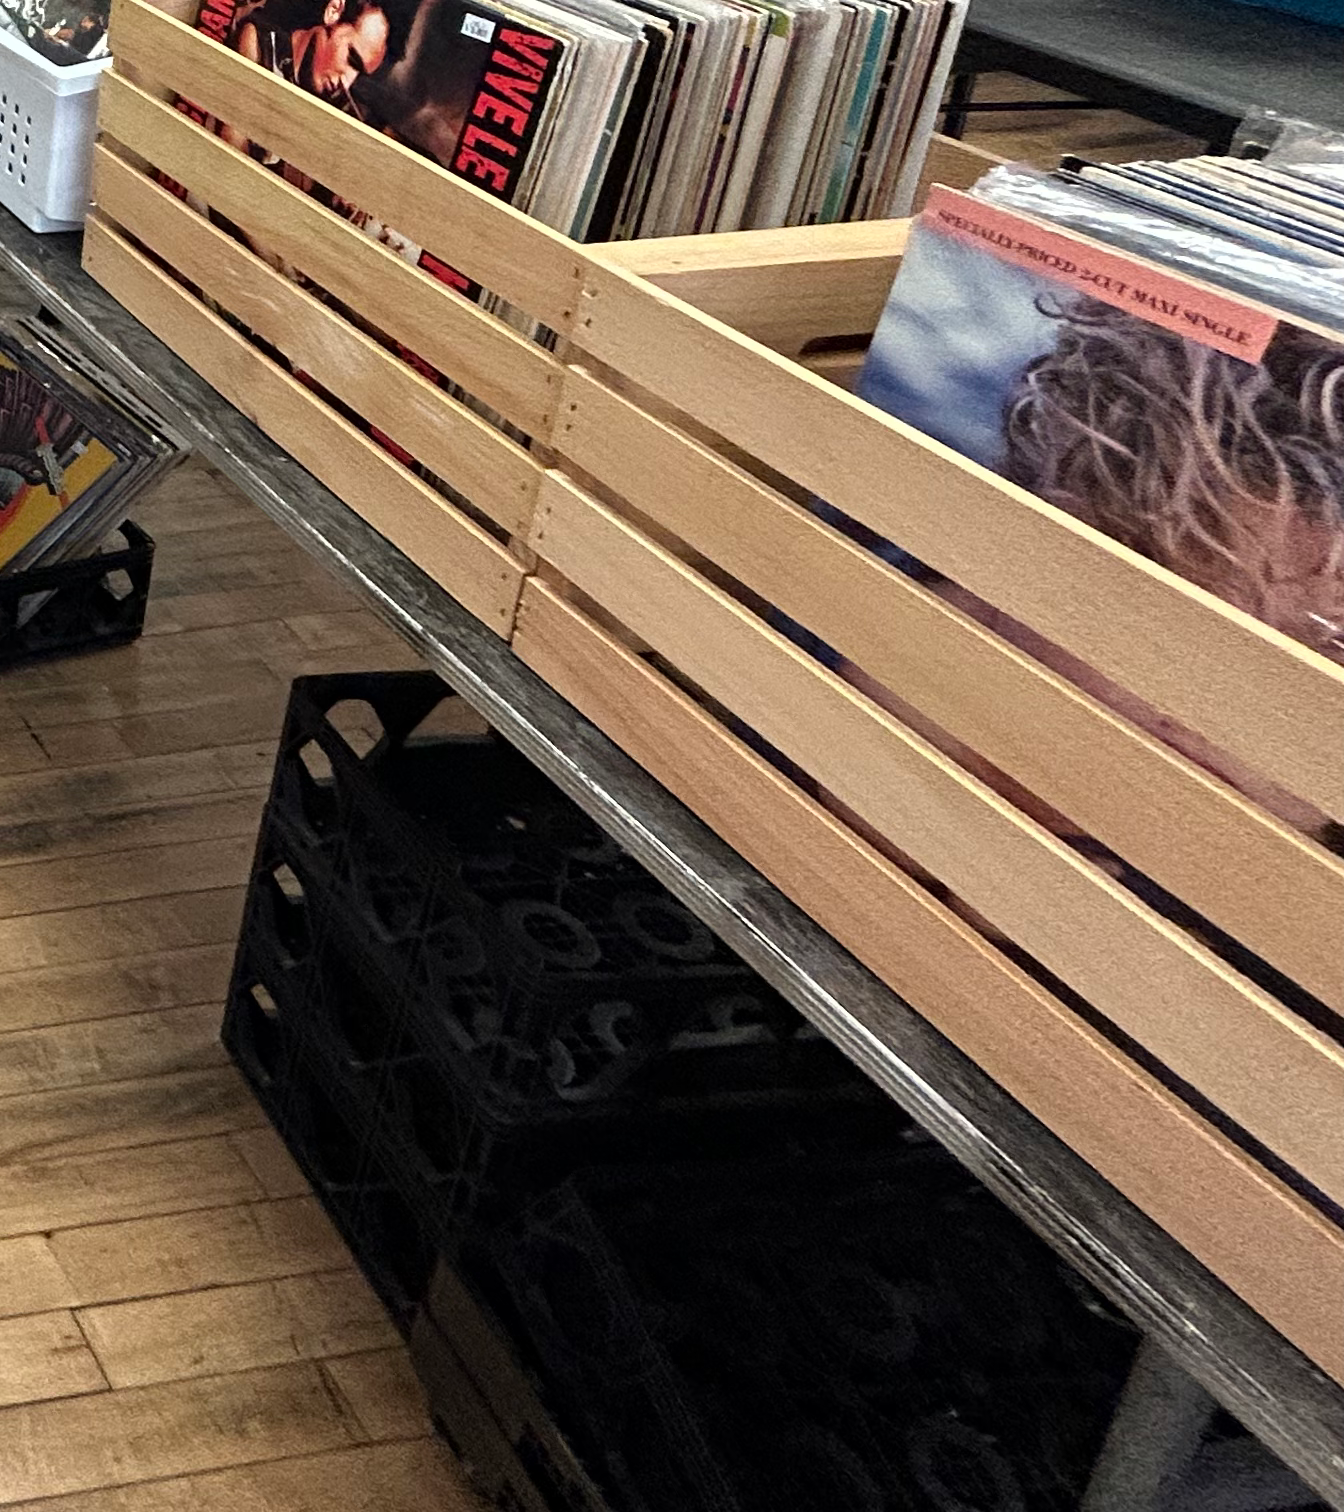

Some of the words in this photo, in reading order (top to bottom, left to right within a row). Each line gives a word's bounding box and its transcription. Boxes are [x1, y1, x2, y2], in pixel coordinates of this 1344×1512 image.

[471, 27, 556, 138] VIVE
[455, 122, 519, 193] LE
[1130, 287, 1179, 317] MAXI
[1183, 310, 1254, 347] SINGLE
